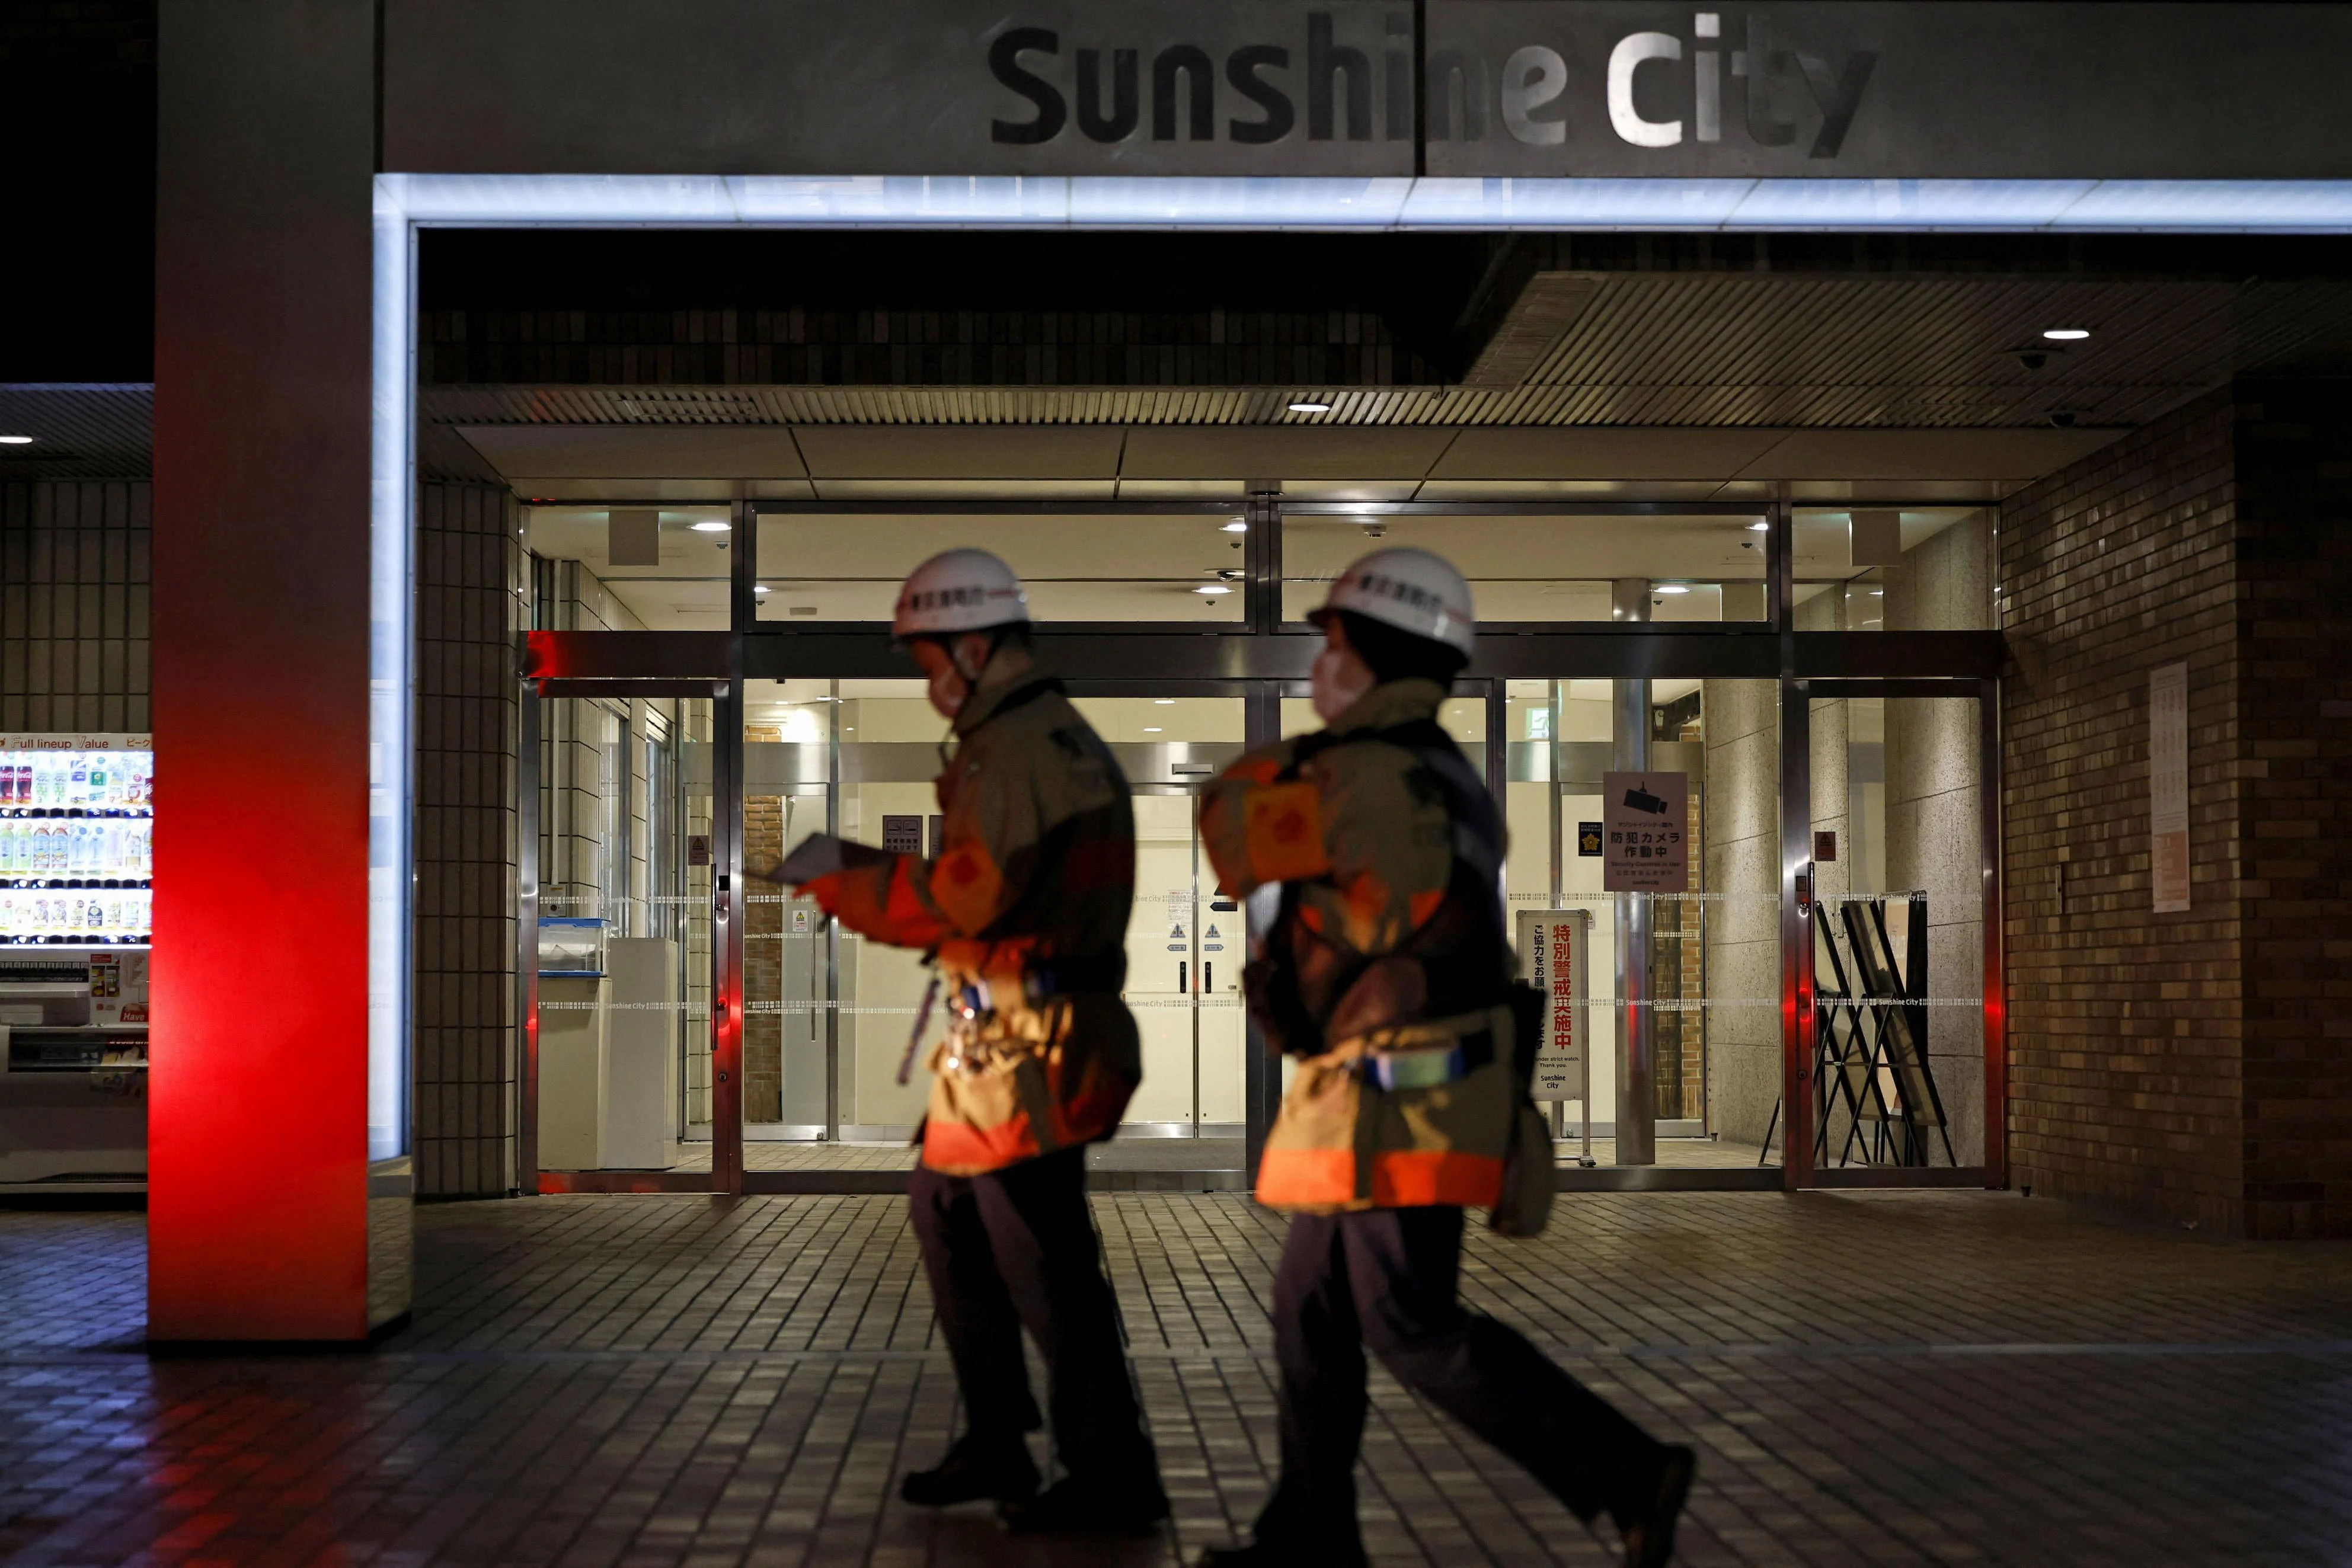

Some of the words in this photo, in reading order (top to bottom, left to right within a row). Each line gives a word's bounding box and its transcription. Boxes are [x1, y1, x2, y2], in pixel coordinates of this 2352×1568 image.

[988, 13, 1567, 146] Sunshine
[1607, 12, 1880, 159] City
[11, 735, 33, 748] Full
[37, 739, 72, 750] lineup
[77, 735, 108, 748] Value
[1610, 832, 1680, 844] 防犯カメラ
[1624, 846, 1667, 858] 作動中
[1553, 924, 1571, 1049] 特別警戒実施中
[123, 1012, 145, 1021] Have
